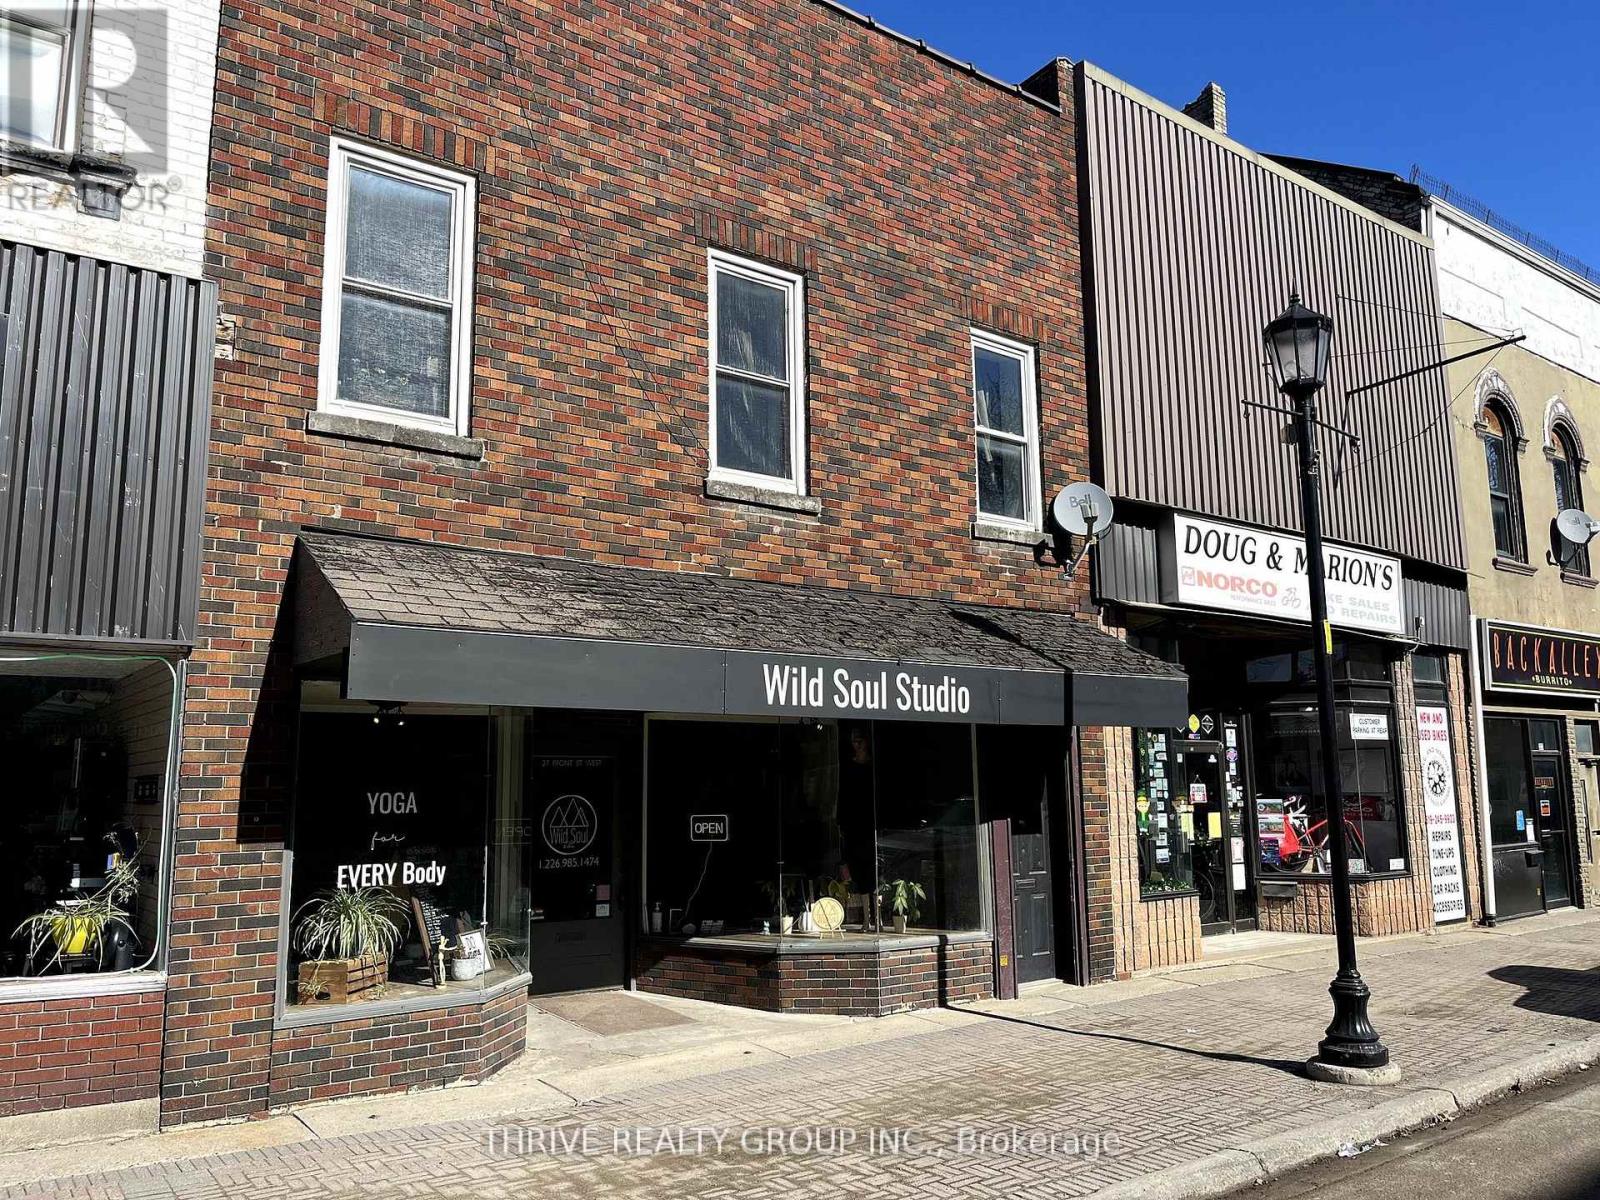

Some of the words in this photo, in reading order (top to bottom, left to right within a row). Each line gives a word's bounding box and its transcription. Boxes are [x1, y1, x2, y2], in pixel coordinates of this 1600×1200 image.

[1184, 525, 1257, 565] DOUG
[1266, 541, 1283, 571] &
[1293, 547, 1393, 591] MRION'S
[1197, 568, 1278, 598] NORCO
[1348, 596, 1390, 612] SALES
[1341, 607, 1397, 625] REPAIRS
[762, 663, 824, 707] Wild
[833, 668, 887, 710] Soul
[896, 672, 970, 714] Studio
[1420, 713, 1430, 723] NEW
[1432, 713, 1443, 724] AND
[1432, 730, 1447, 741] BIKES
[367, 791, 417, 814] YOGA
[550, 828, 568, 845] Wild
[570, 827, 589, 844] Soul
[694, 821, 724, 834] OPEN
[1432, 830, 1452, 842] REPAIRS
[371, 832, 405, 850] for
[1432, 848, 1454, 859] TUNE-UPS
[337, 862, 397, 891] EVERY
[403, 861, 446, 886] Body
[1433, 865, 1457, 877] CLOTHING
[1434, 884, 1443, 896] CAR
[1445, 882, 1460, 894] RACKS
